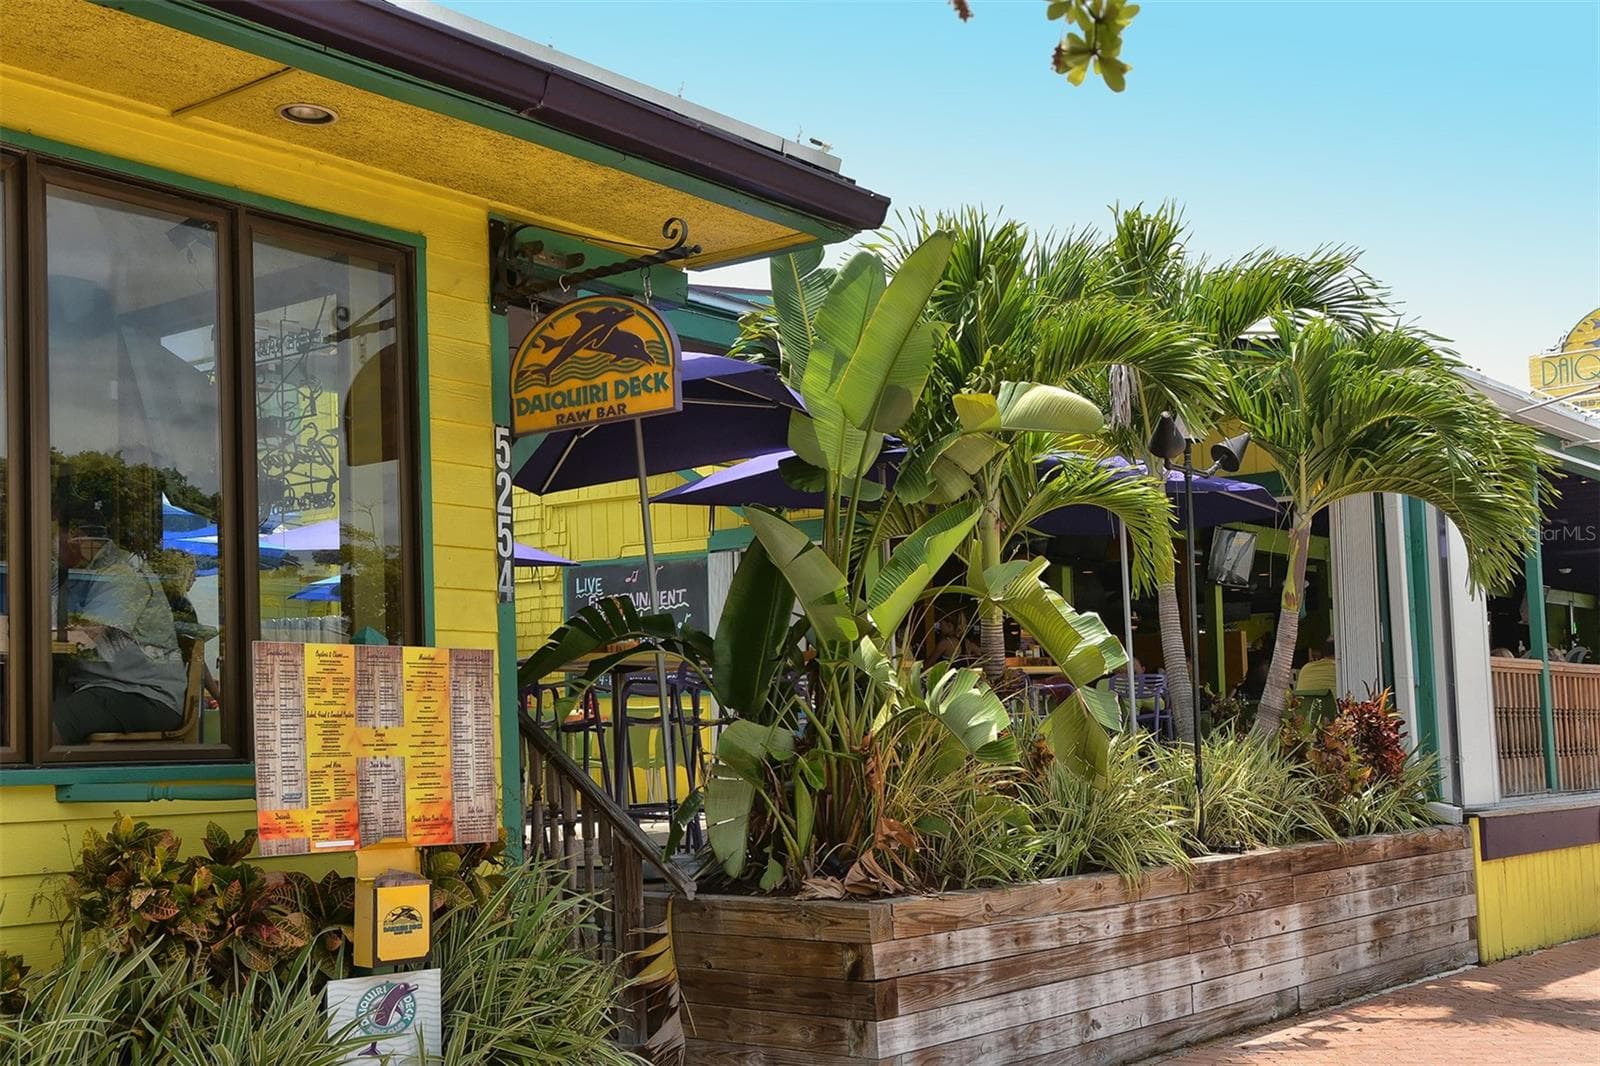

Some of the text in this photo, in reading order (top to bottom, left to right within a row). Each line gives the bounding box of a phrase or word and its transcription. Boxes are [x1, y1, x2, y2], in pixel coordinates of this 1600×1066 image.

[516, 371, 670, 417] DAIQUIRI DECK
[556, 402, 628, 425] RAW BAR
[495, 427, 514, 602] 5254
[575, 577, 602, 593] LIVE
[403, 995, 415, 1021] DECK
